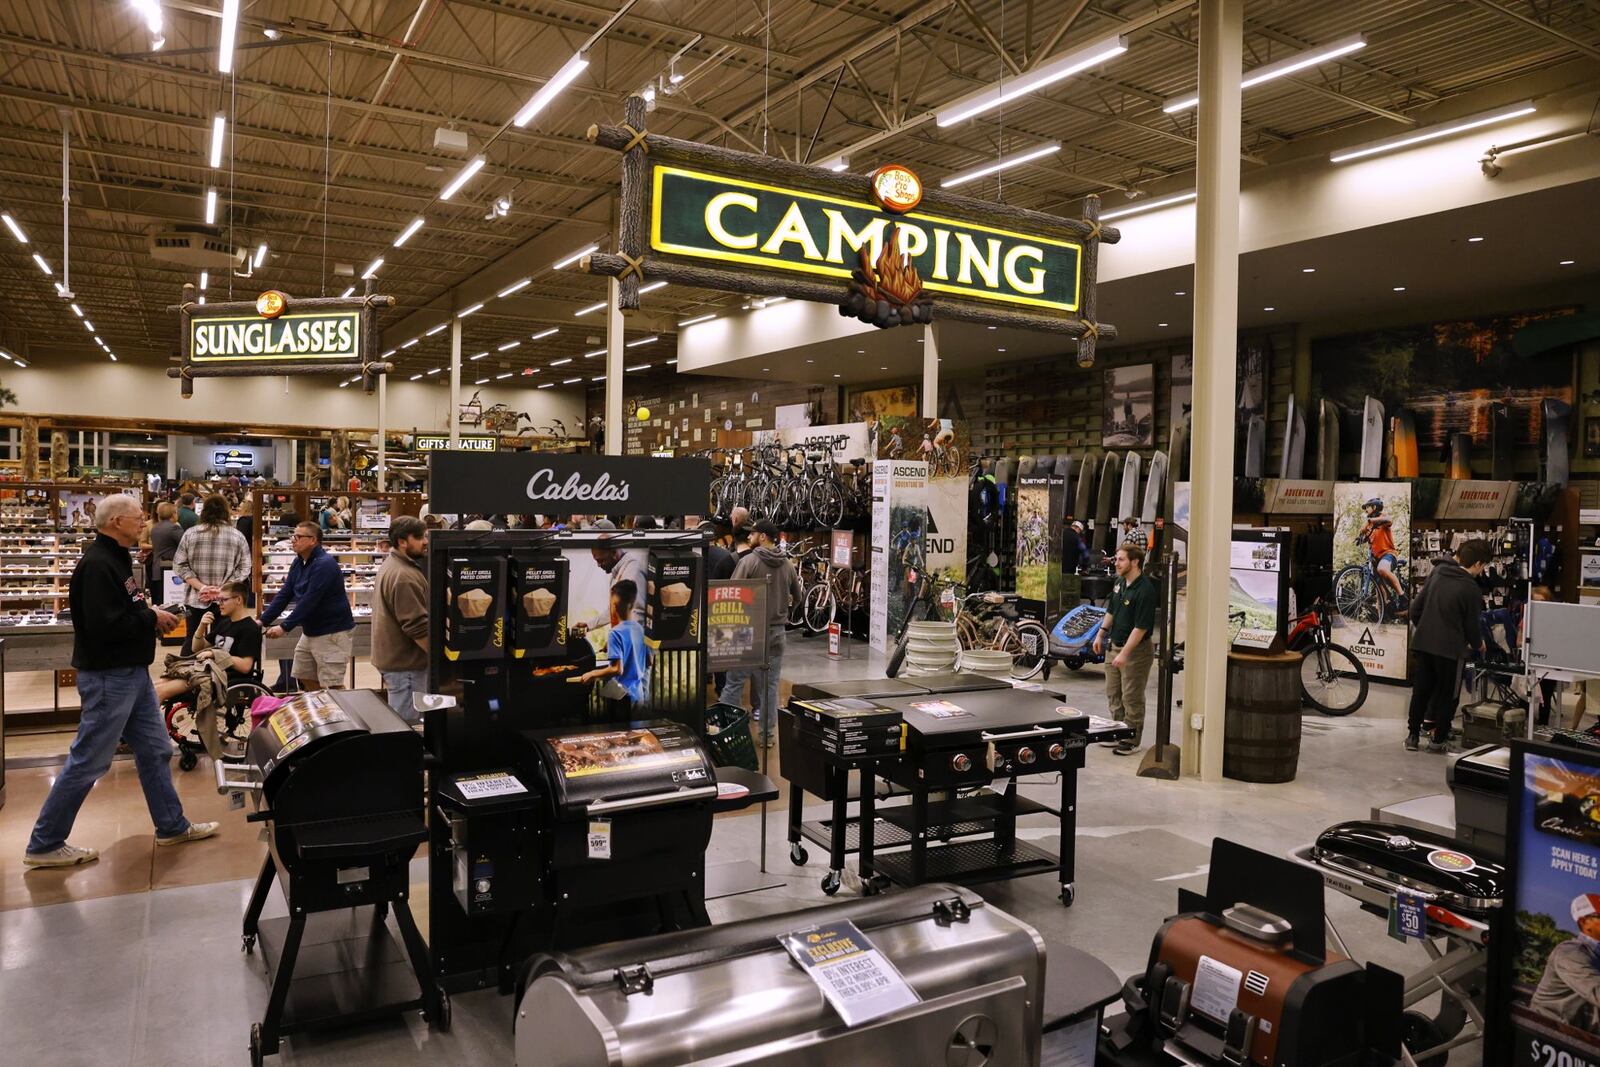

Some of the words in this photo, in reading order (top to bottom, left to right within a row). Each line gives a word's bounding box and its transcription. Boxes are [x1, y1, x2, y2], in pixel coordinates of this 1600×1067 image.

[895, 171, 911, 182] Bass
[895, 182, 908, 190] Pro
[704, 191, 1045, 294] CAMPING
[196, 320, 352, 355] SUNGLASSES
[418, 439, 444, 449] GIFTS
[804, 434, 848, 452] ASCEND
[893, 467, 926, 477] ASCEND
[526, 468, 630, 501] Cabela's
[926, 539, 954, 553] END
[715, 587, 742, 600] FREE
[712, 602, 744, 614] GRILL
[493, 617, 504, 647] Cabela's
[557, 616, 567, 645] Cabela's
[1350, 645, 1385, 657] ASCEND
[1540, 816, 1584, 836] Classic
[1551, 846, 1571, 860] SCAN
[1572, 850, 1590, 866] HERE
[1591, 857, 1598, 868] &
[1551, 858, 1573, 872] APPLY
[1574, 864, 1598, 880] TODAY
[1326, 877, 1352, 891] TRAVELER
[1402, 912, 1419, 930] $50
[806, 937, 854, 958] EXCLUSIVE
[823, 968, 836, 980] 0%
[837, 958, 876, 976] INTEREST
[831, 978, 846, 990] FOR
[846, 976, 854, 986] 12
[854, 967, 882, 982] MONTHS
[839, 987, 857, 999] THEN
[876, 976, 892, 986] APR
